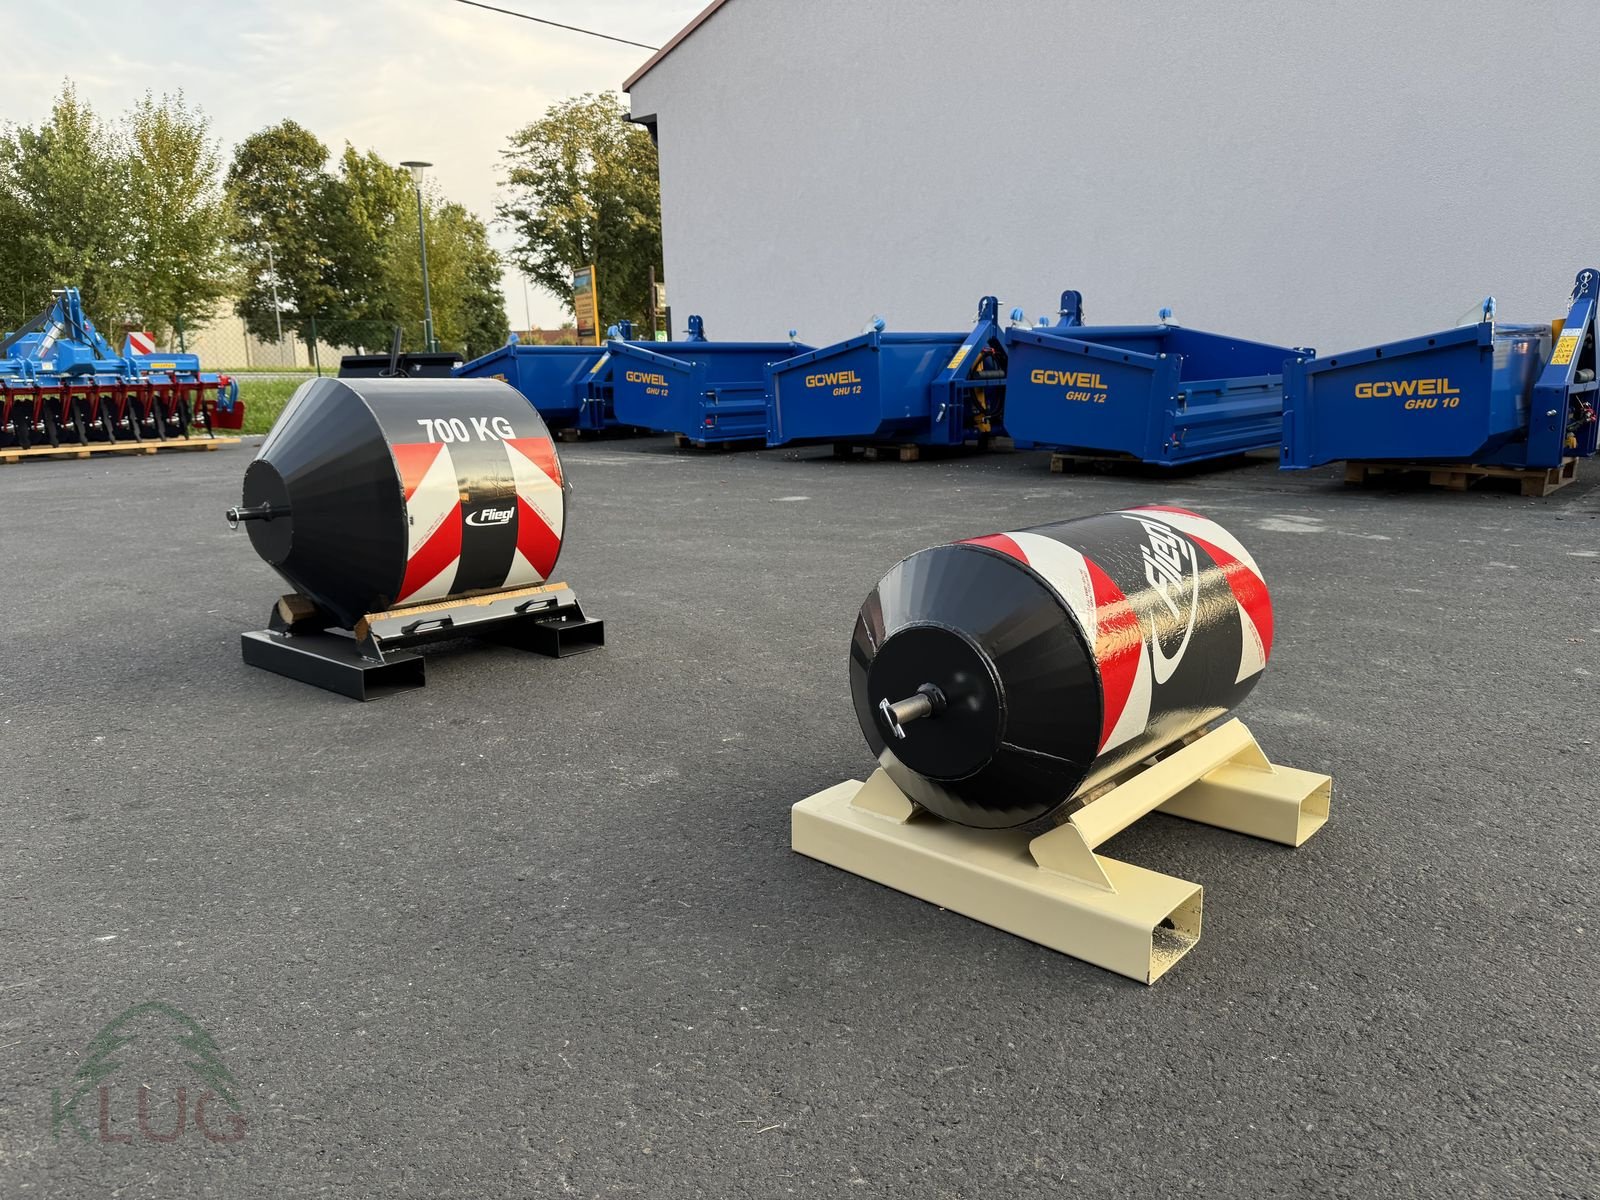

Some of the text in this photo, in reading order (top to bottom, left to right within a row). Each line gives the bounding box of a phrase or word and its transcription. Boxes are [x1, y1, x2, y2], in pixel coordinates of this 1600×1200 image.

[646, 387, 660, 395] GHU
[833, 385, 862, 396] GHU 12
[1066, 391, 1107, 403] GHU 12
[1404, 397, 1460, 409] GHU 10
[417, 417, 517, 443] 700 KG
[480, 506, 515, 523] Fliegl
[1121, 514, 1190, 621] Fliegl
